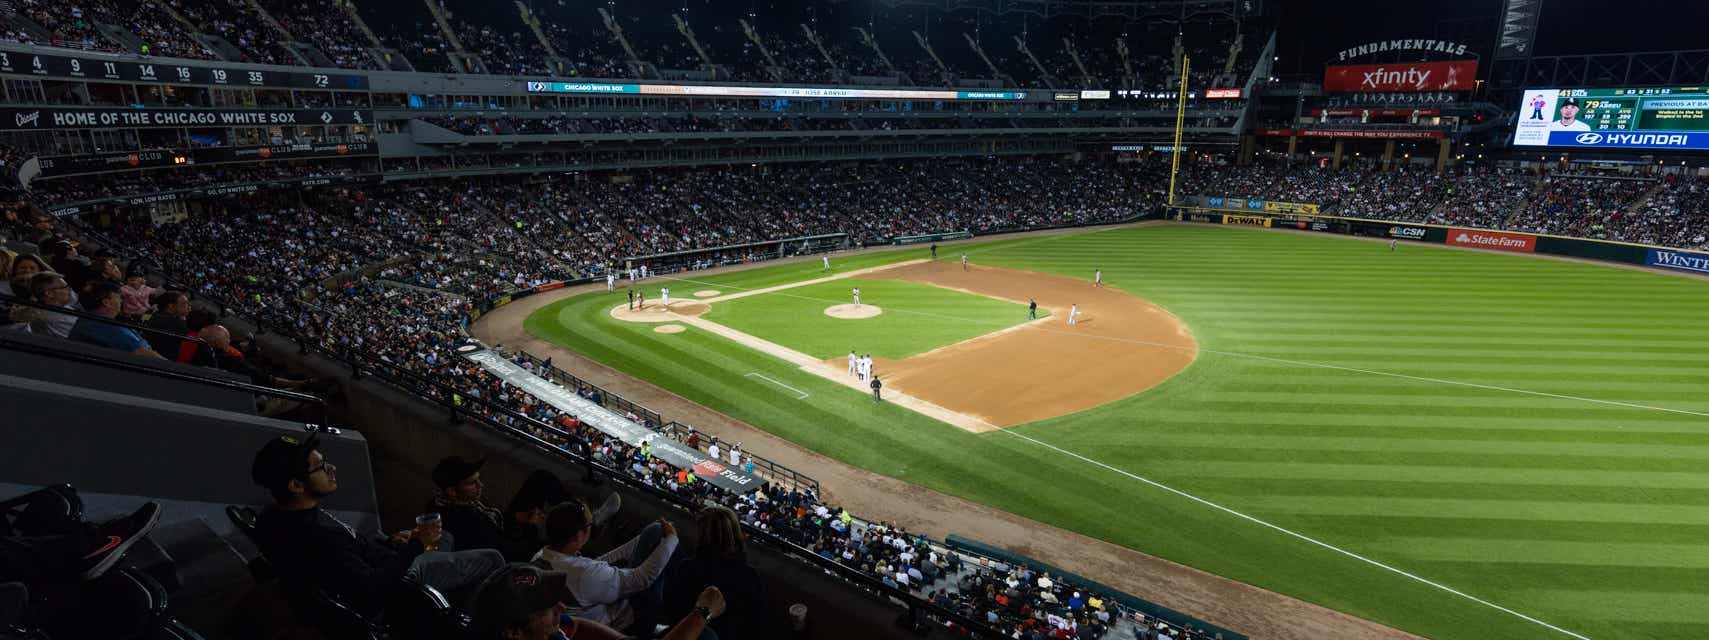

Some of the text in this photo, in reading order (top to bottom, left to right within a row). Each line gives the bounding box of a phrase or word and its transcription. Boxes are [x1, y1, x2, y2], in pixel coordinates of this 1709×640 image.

[1338, 39, 1467, 61] FUNDAMENTALS
[0, 52, 9, 67] 3
[33, 56, 42, 69] 4
[71, 59, 81, 72] 9
[104, 62, 117, 75] 11
[139, 65, 155, 77] 14
[176, 67, 191, 79] 16
[212, 70, 227, 81] 19
[248, 71, 263, 82] 35
[314, 74, 329, 85] 72
[1362, 68, 1431, 89] xfinity
[592, 84, 611, 92] WHITE
[1560, 89, 1571, 97] 41
[1585, 101, 1600, 109] 79
[16, 110, 40, 127] Chicago
[53, 112, 297, 126] HOME OF THE CHICAGO WHITE SOX
[1606, 133, 1688, 145] HYUNDAI
[138, 152, 162, 162] CLUB
[39, 158, 55, 169] LUB
[1402, 227, 1426, 236] CSN
[719, 469, 752, 485] Field
